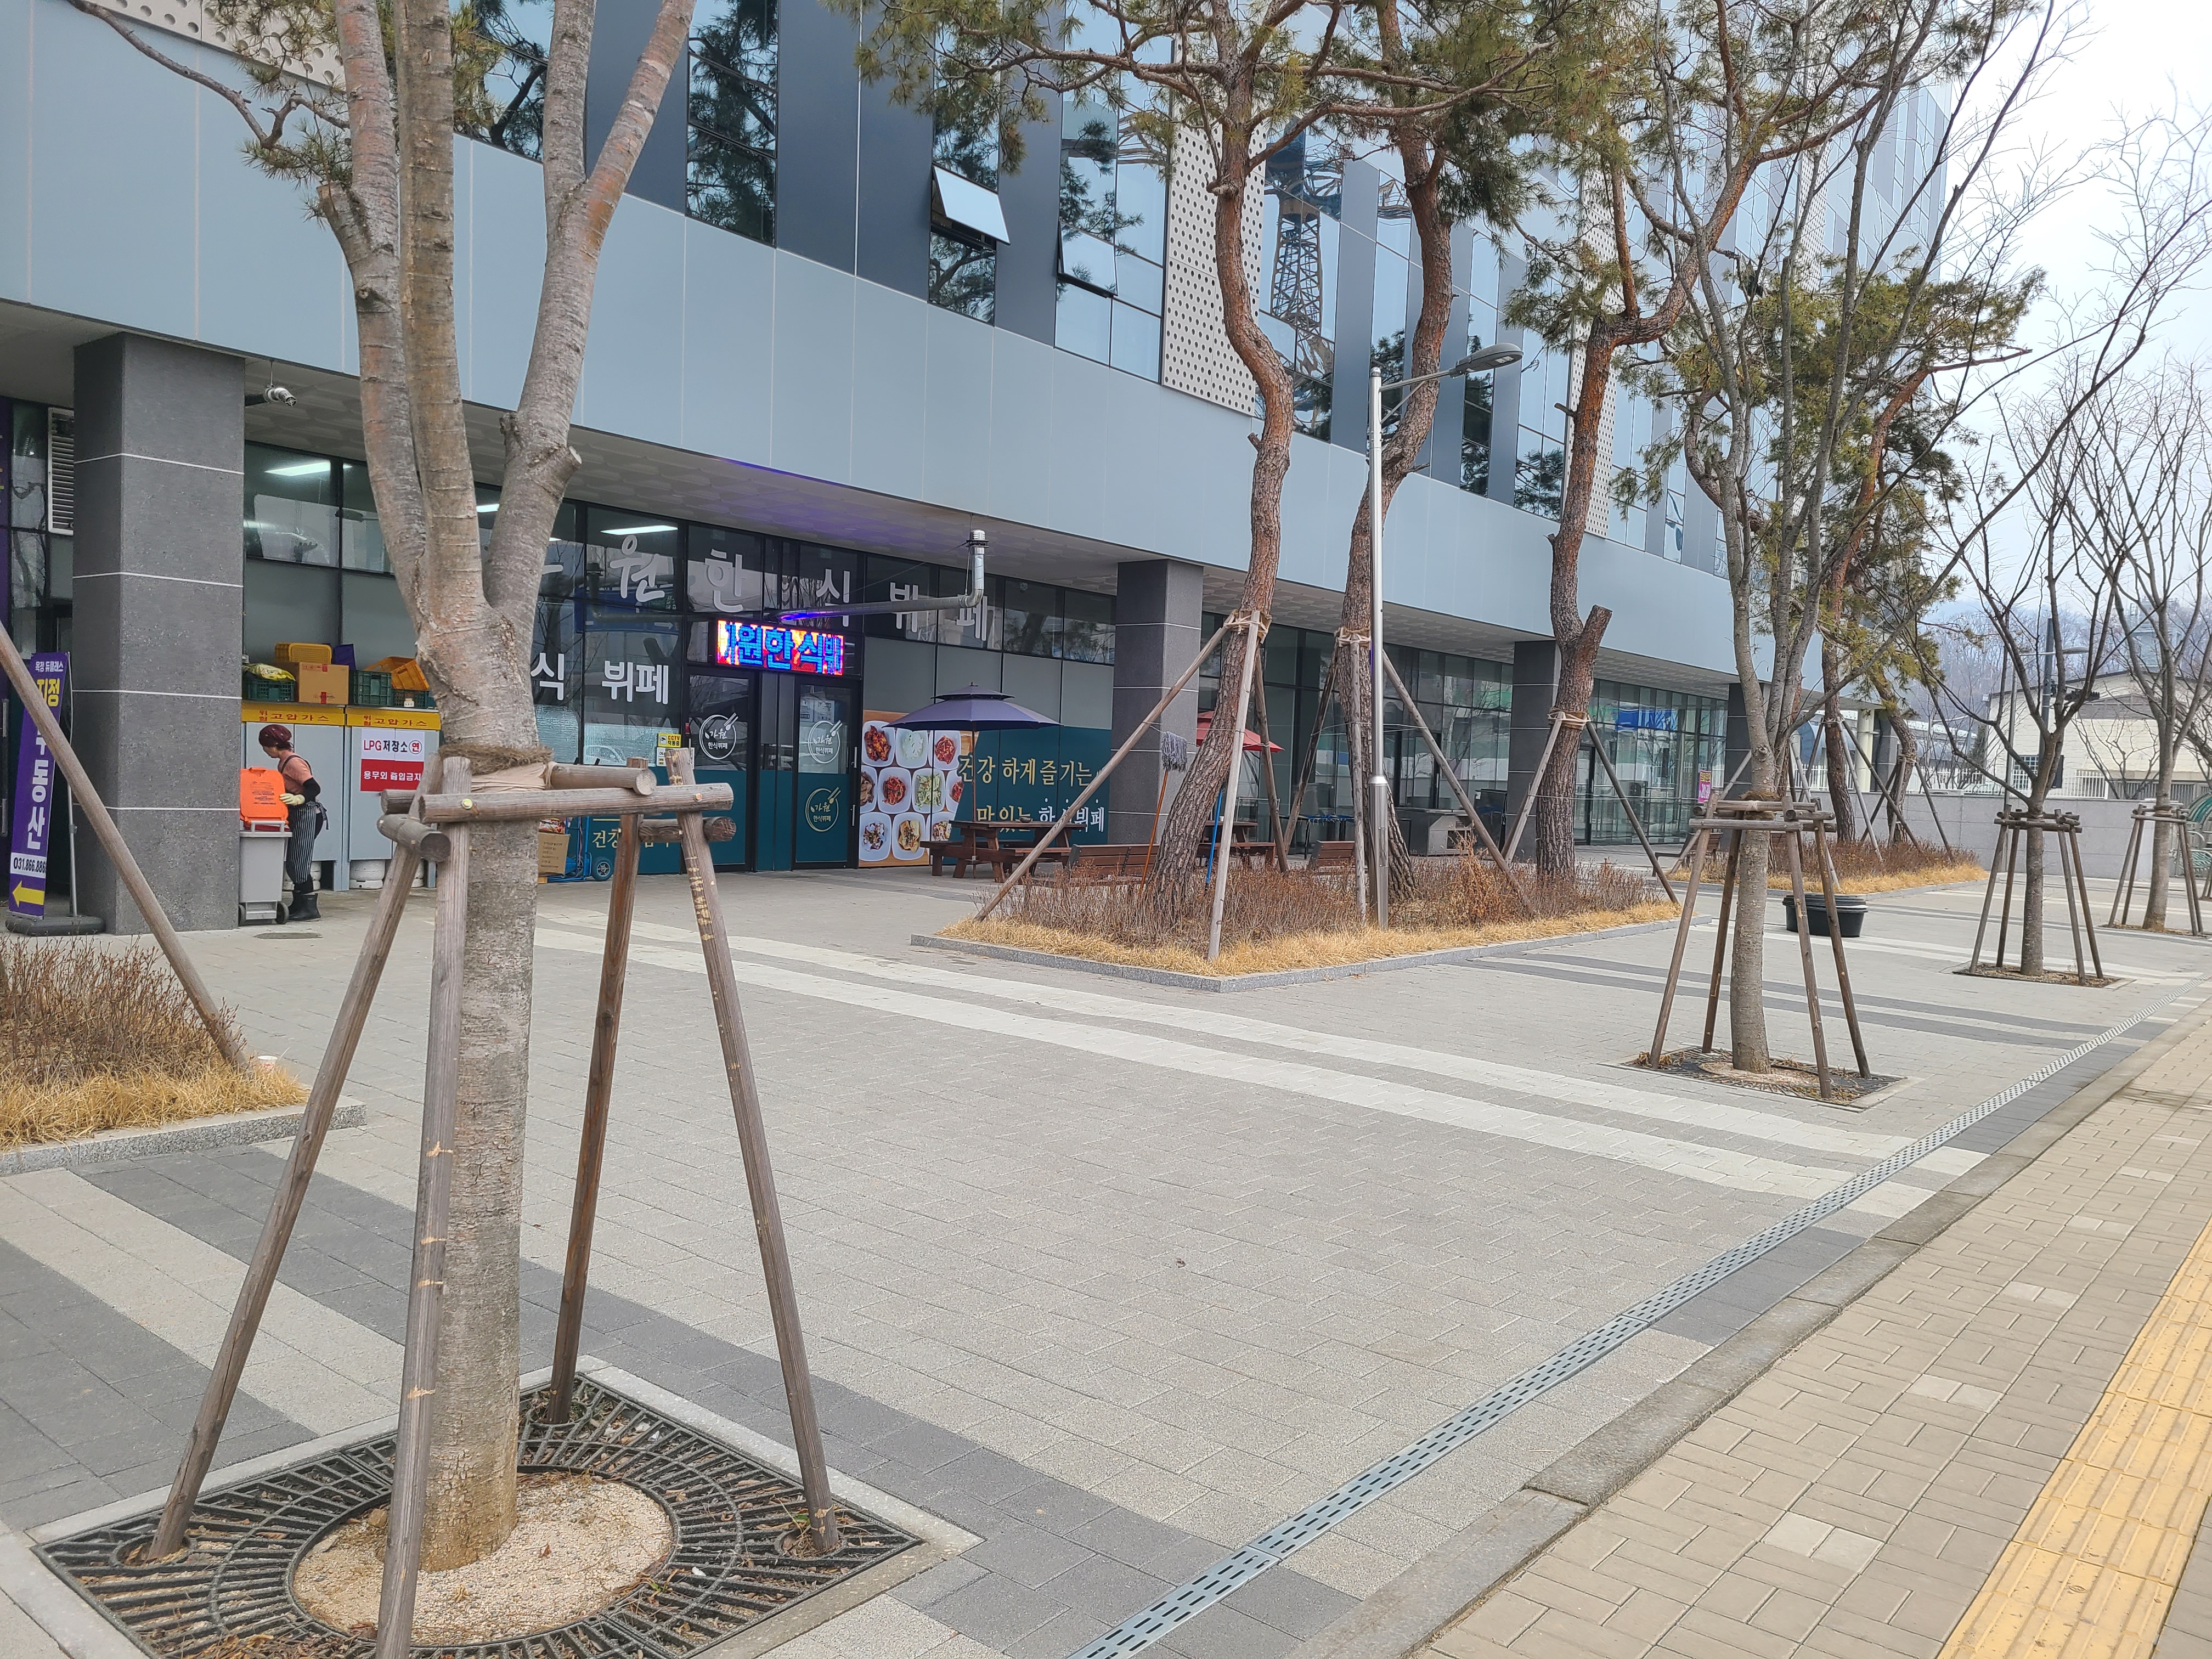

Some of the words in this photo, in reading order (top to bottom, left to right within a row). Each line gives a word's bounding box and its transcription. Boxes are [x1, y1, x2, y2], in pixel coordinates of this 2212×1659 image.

[602, 660, 669, 704] 뷔페
[270, 713, 330, 721] 고압가스
[374, 718, 427, 726] 고압가스
[709, 728, 727, 740] 가원
[816, 735, 833, 745] 가원
[708, 742, 728, 750] 한식뷔페
[364, 771, 387, 780] 용무외
[1040, 759, 1092, 787] 즐기는
[815, 803, 831, 812] 가원
[13, 857, 46, 874] 031.866.886
